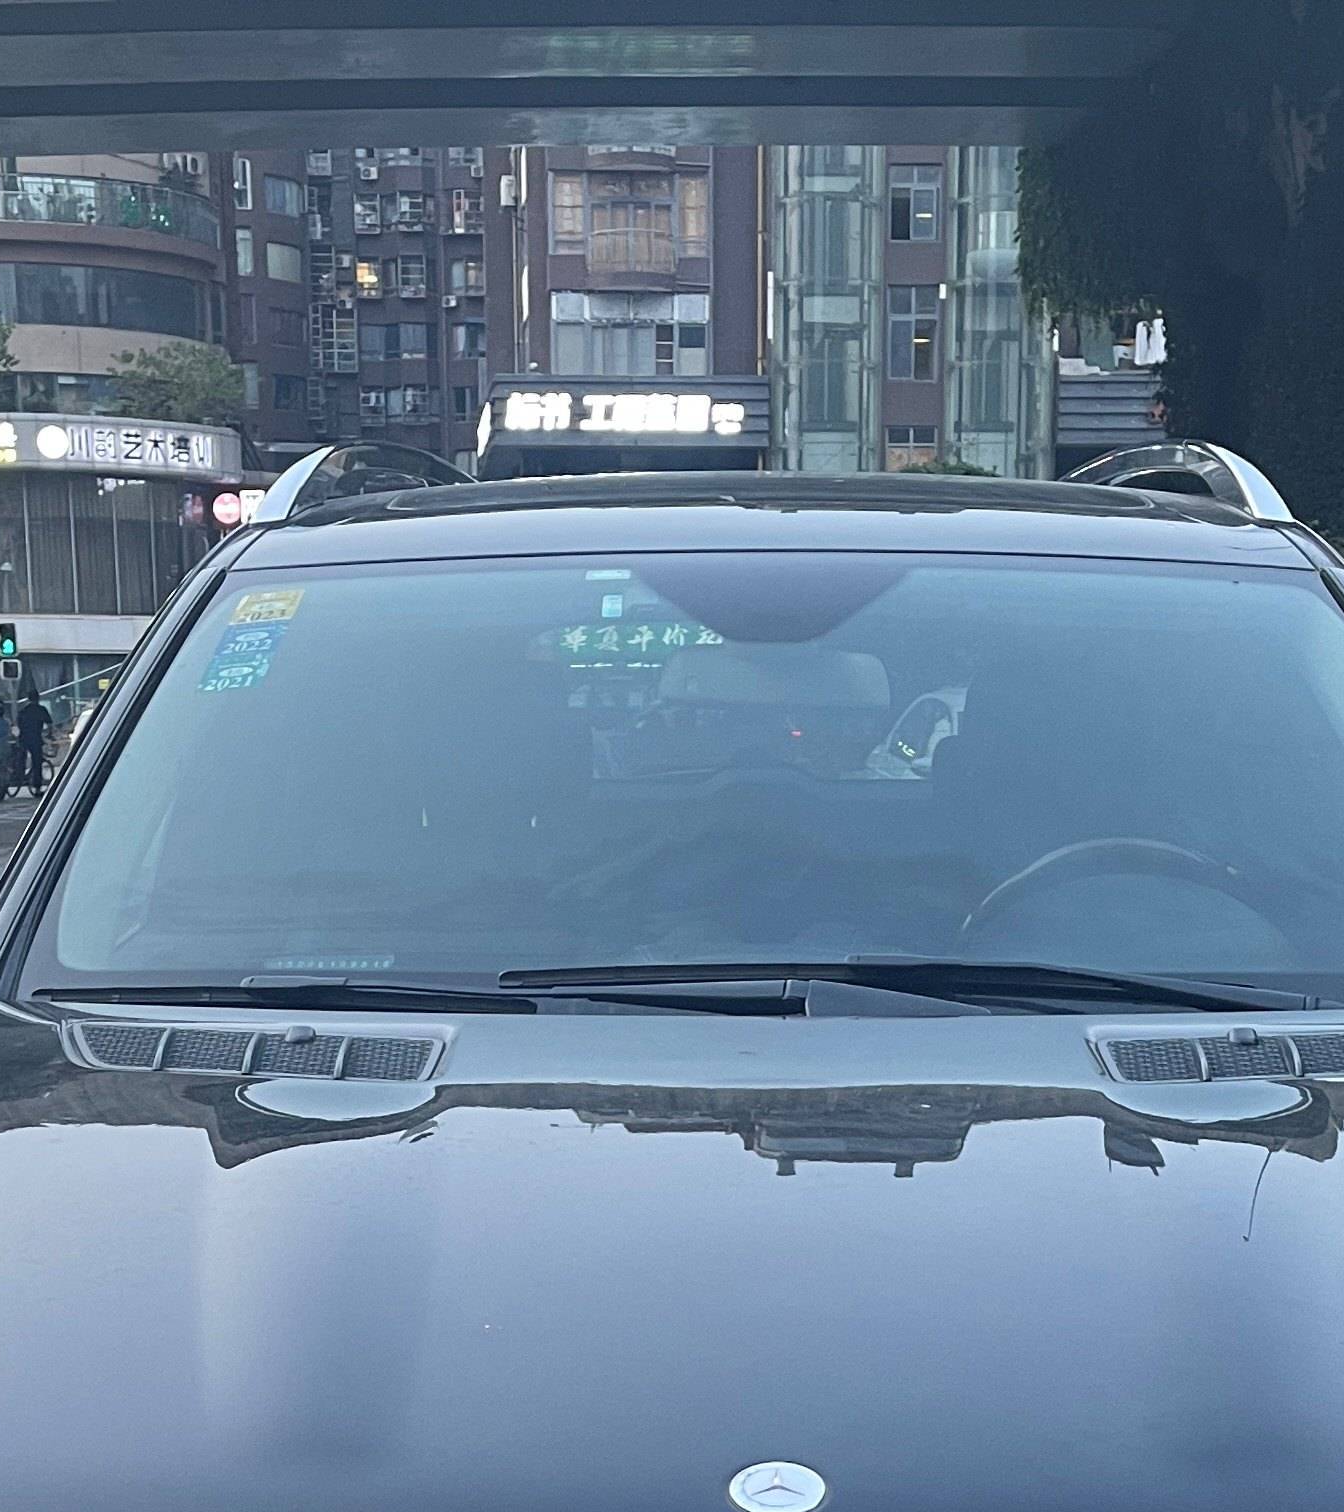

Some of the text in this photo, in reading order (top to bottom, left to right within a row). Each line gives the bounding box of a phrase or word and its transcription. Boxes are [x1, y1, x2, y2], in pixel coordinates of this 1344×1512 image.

[67, 426, 213, 469] 川韵艺术培训
[238, 608, 288, 623] 2023
[220, 638, 273, 655] 2022
[202, 675, 255, 692] 2021
